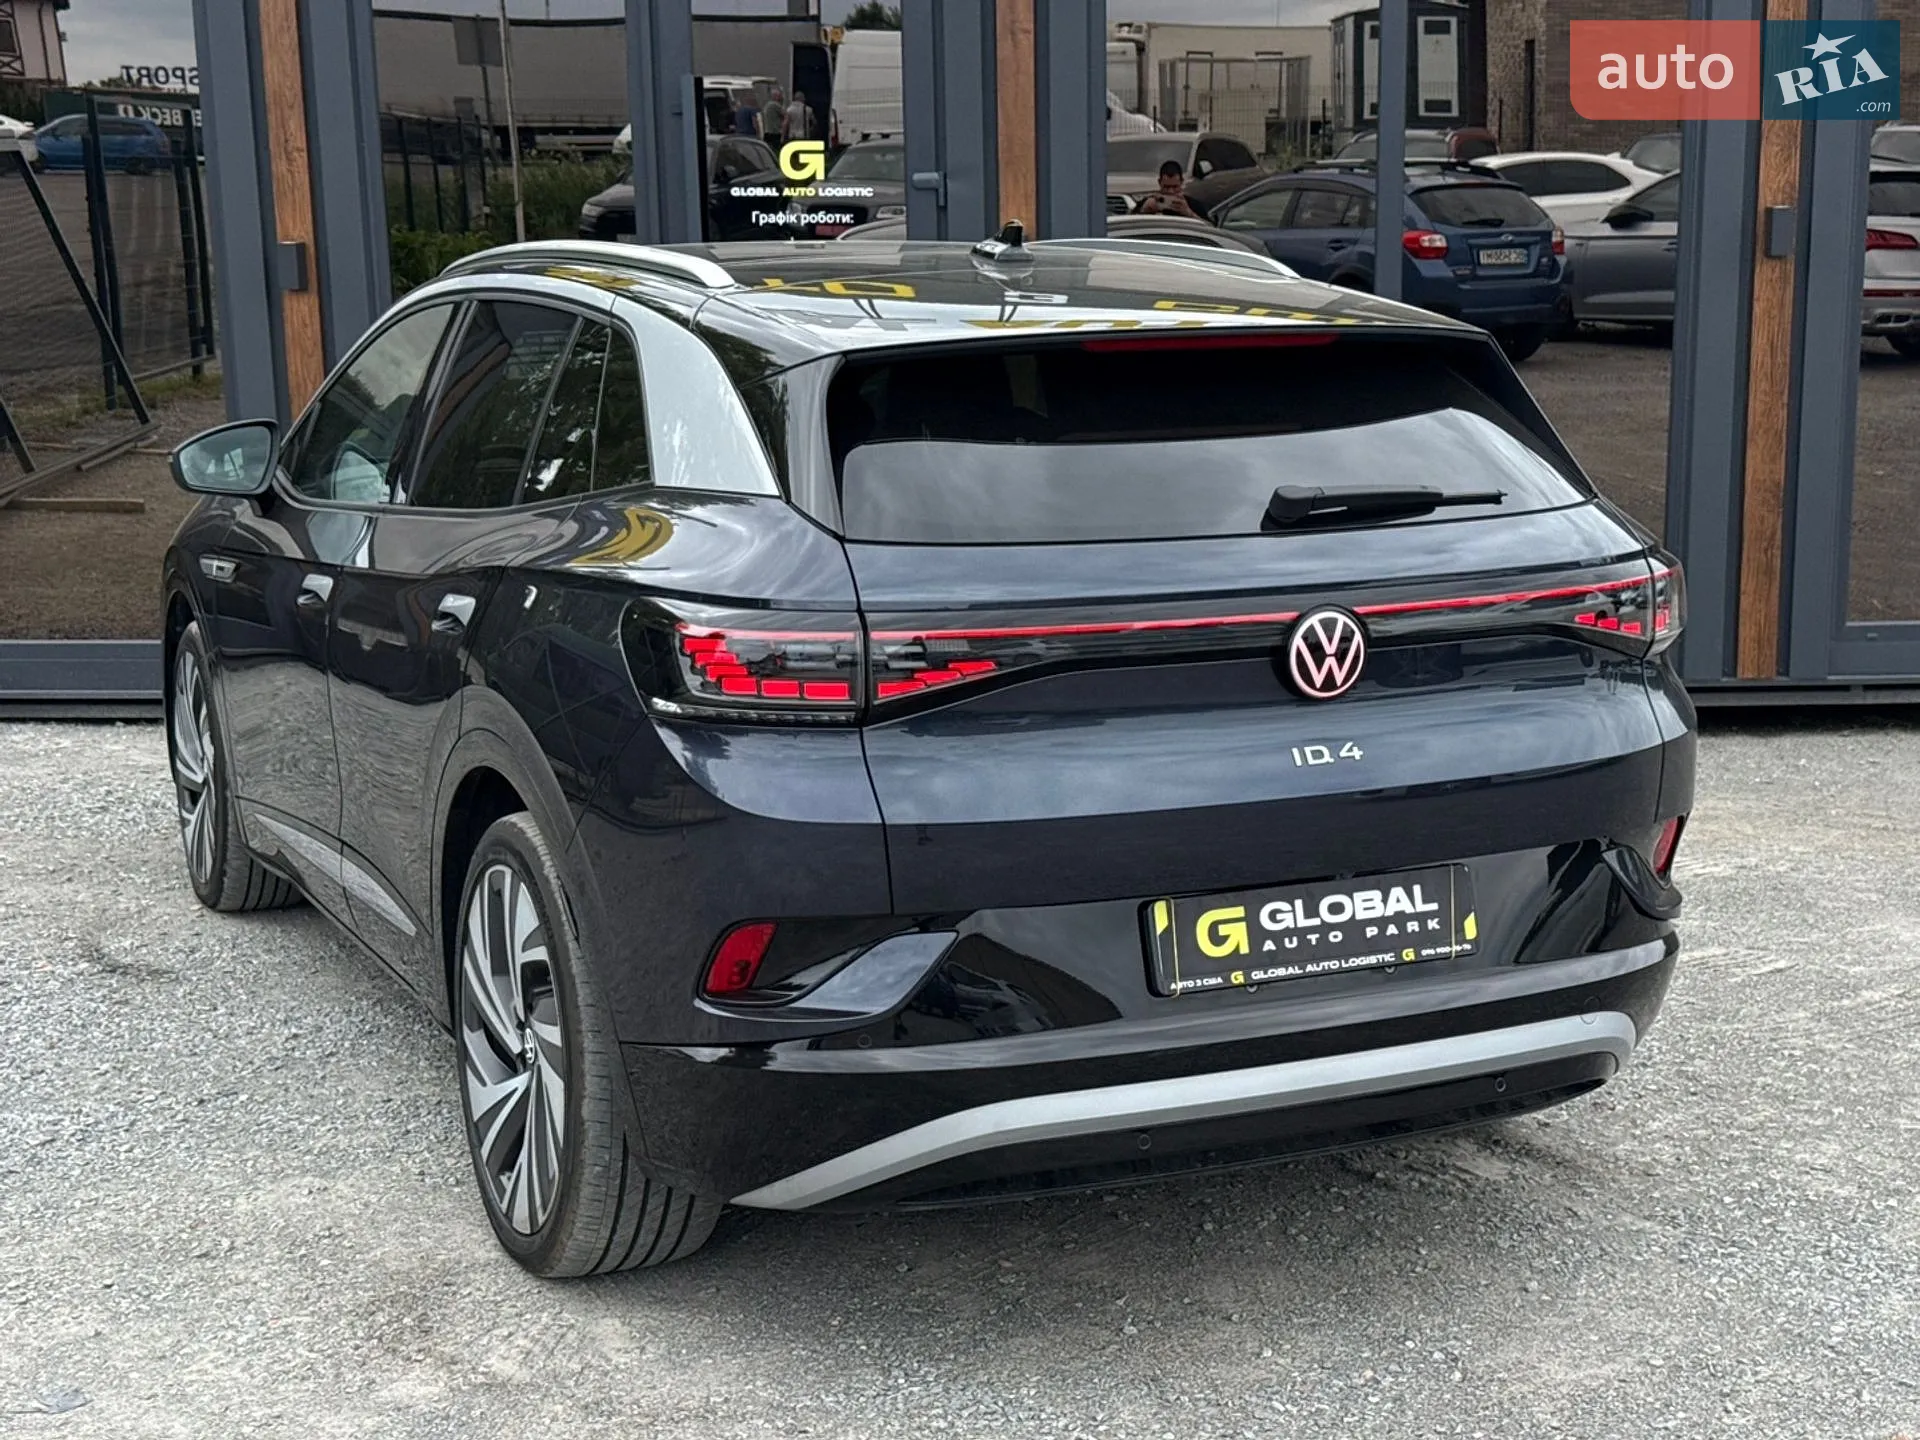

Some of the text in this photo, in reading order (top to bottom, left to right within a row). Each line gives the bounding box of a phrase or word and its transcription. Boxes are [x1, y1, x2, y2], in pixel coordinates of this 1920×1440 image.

[730, 187, 874, 197] GLOBAL AUTO LOGISTIC
[751, 210, 854, 226] Графік роботи:
[1259, 884, 1439, 931] GLOBAL
[1262, 917, 1441, 952] AUTO PARK
[1251, 952, 1395, 981] GLOBAL AUTO LOGISTIC
